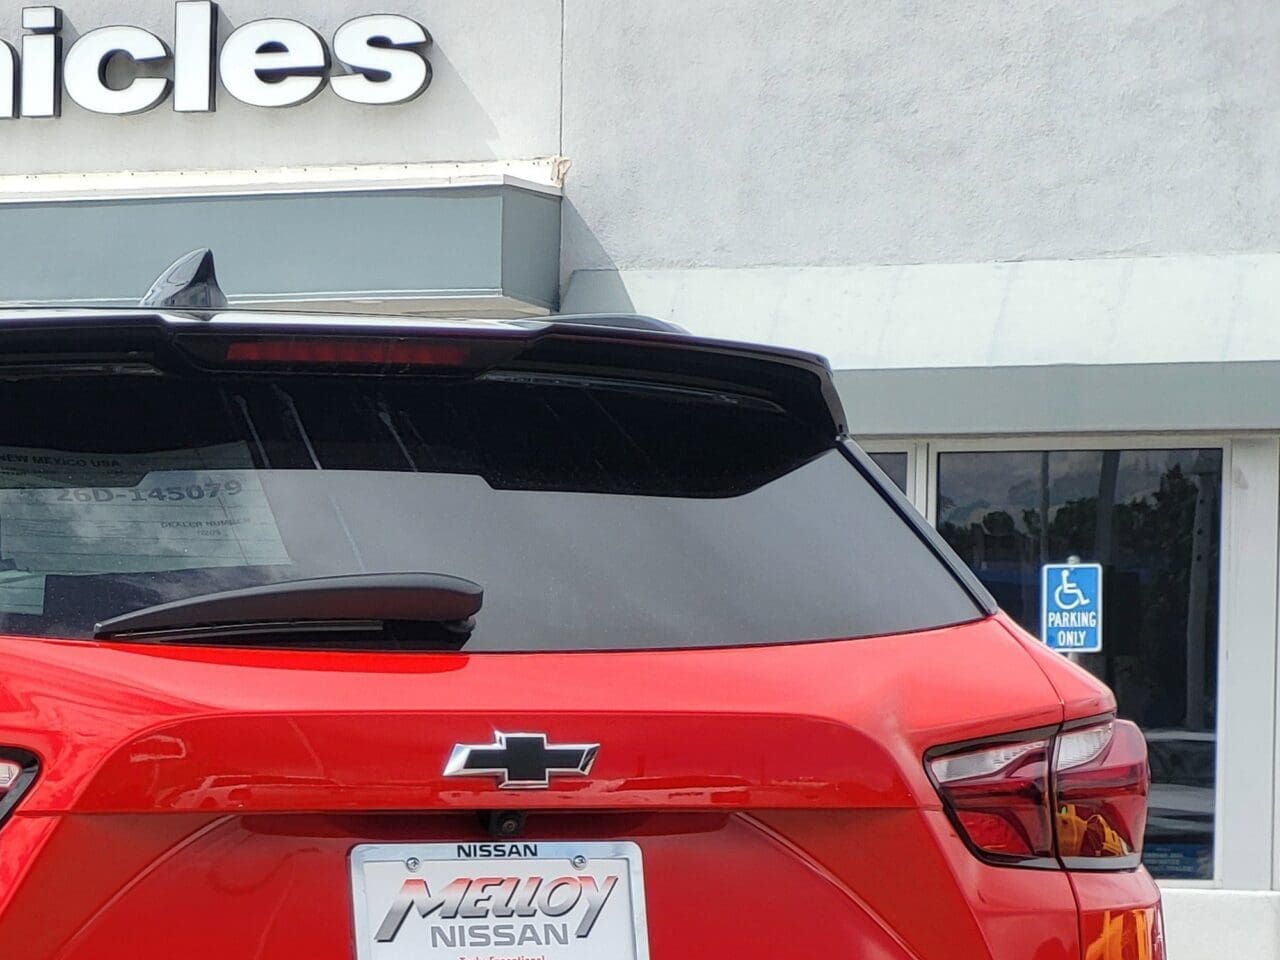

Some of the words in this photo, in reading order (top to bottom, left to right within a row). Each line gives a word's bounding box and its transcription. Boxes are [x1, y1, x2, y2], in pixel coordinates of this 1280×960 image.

[32, 455, 87, 467] MEXICO
[89, 458, 120, 468] USA
[1048, 611, 1097, 628] PARKING
[1058, 630, 1087, 646] ONLY
[456, 843, 538, 858] NISSAN
[373, 875, 619, 943] MELLOY
[431, 923, 569, 948] NISSAN
